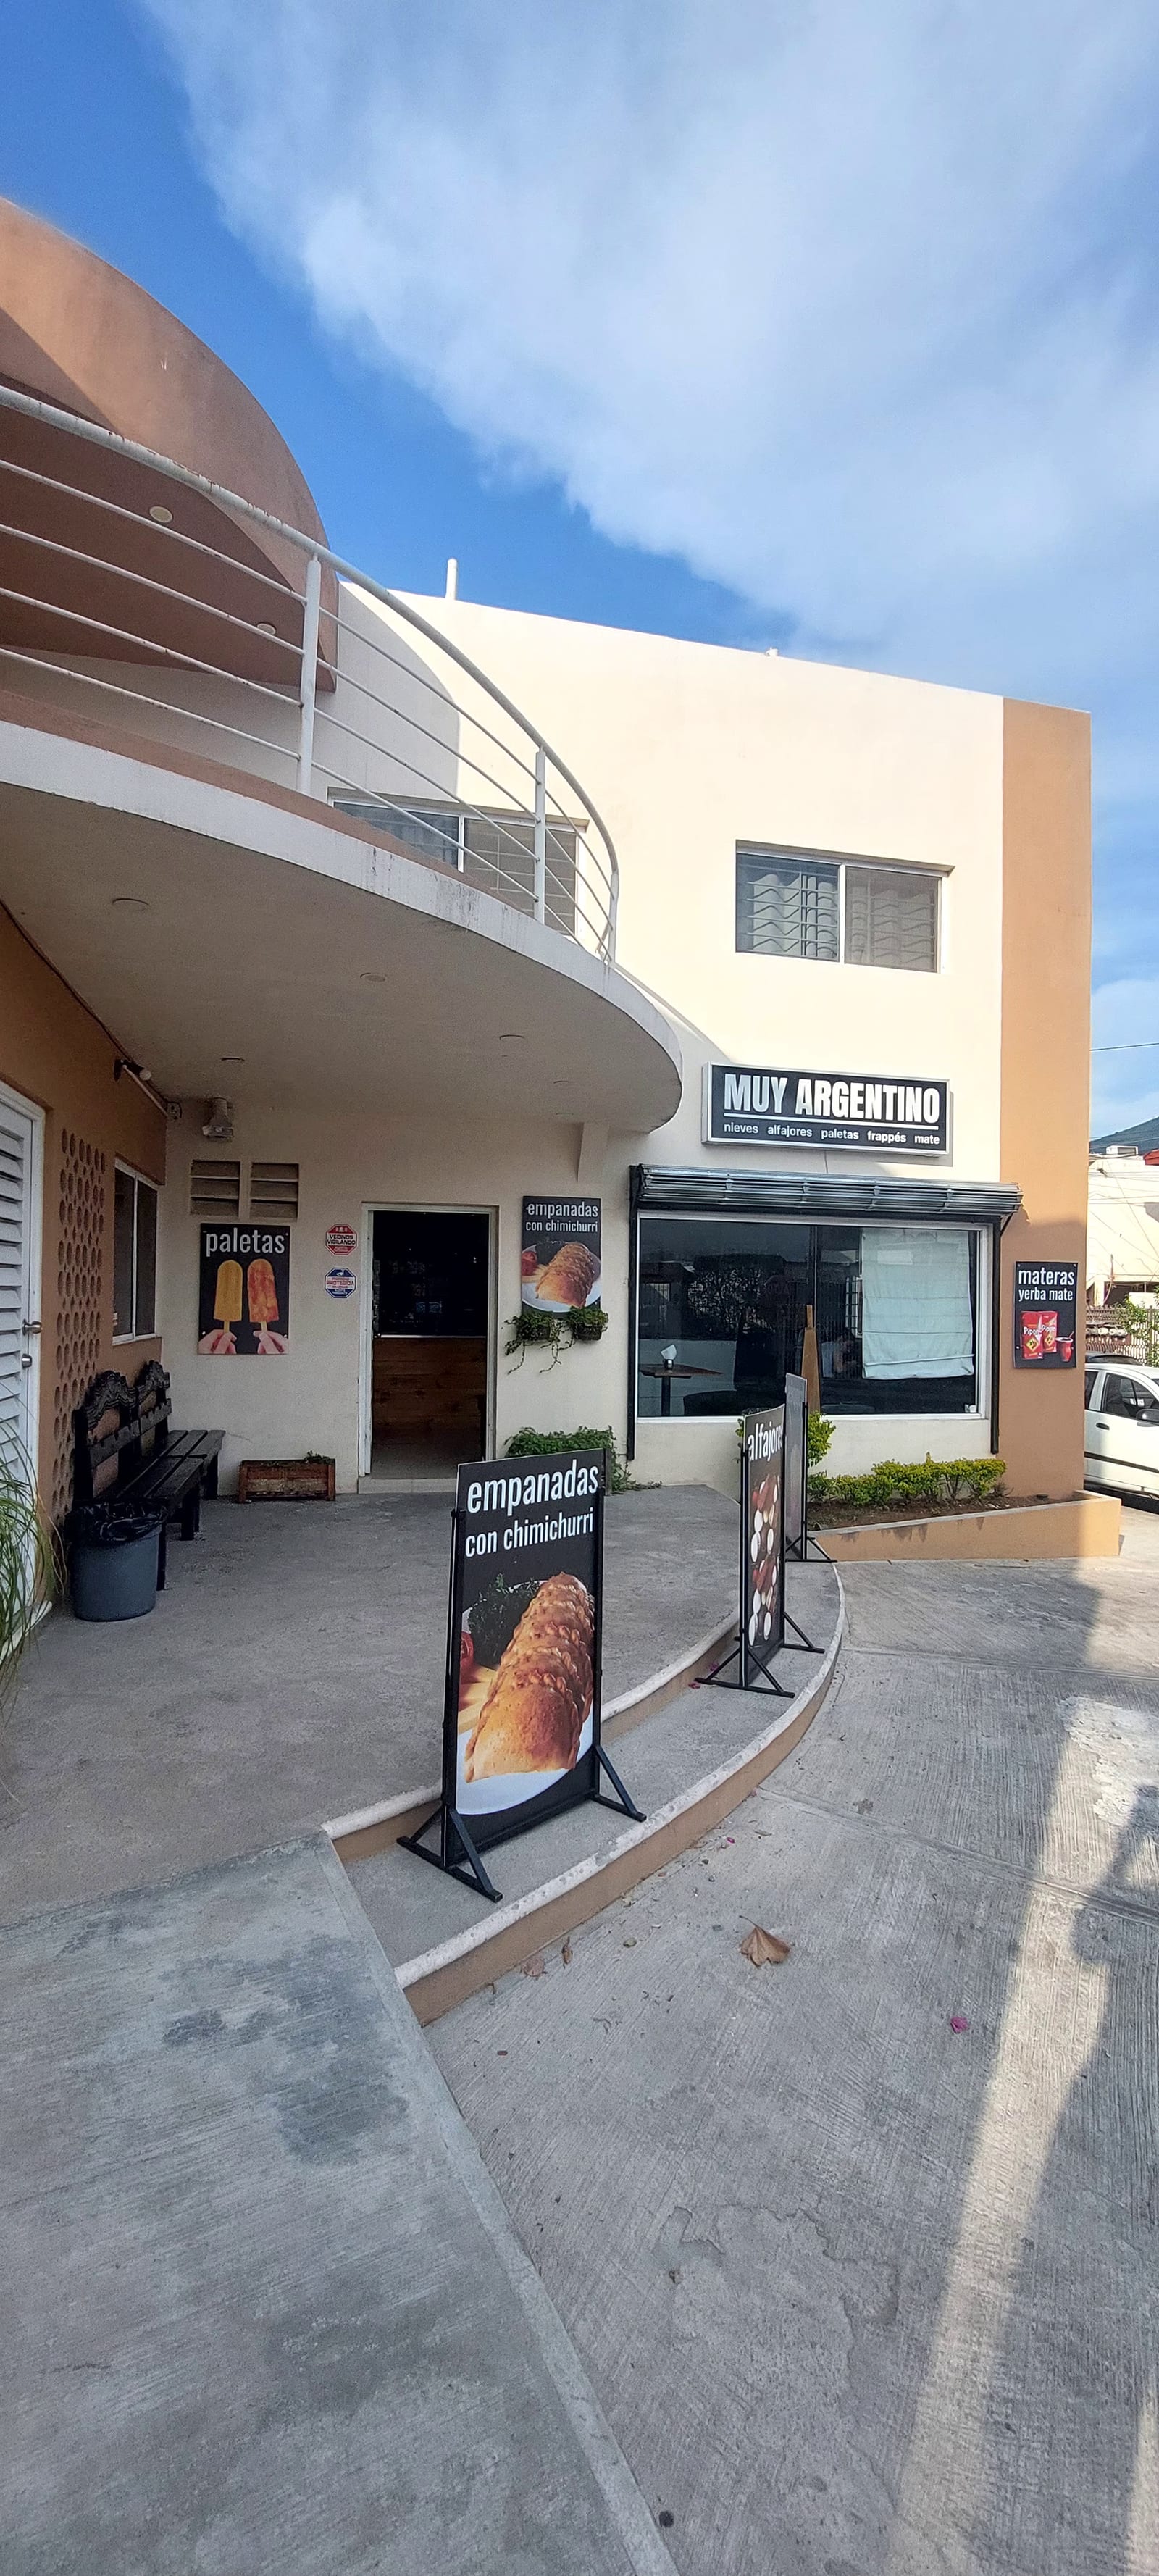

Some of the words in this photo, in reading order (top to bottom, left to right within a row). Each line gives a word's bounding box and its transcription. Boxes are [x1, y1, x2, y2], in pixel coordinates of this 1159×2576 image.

[724, 1073, 788, 1113] MUY
[795, 1079, 940, 1124] ARGENTINO
[724, 1122, 759, 1134] nieves
[767, 1125, 813, 1138] alfajores
[821, 1128, 860, 1140] paletas
[867, 1130, 907, 1145] frappés
[914, 1134, 940, 1145] mate
[527, 1201, 599, 1219] empanadas
[525, 1221, 543, 1231] con
[545, 1219, 598, 1233] chimichurri
[206, 1227, 285, 1257] paletas
[1018, 1267, 1075, 1286] materas
[1018, 1287, 1046, 1302] yerba
[1049, 1288, 1074, 1301] mate
[467, 1458, 599, 1517] empanadas
[465, 1531, 498, 1557] con
[503, 1507, 594, 1550] chimichurri
